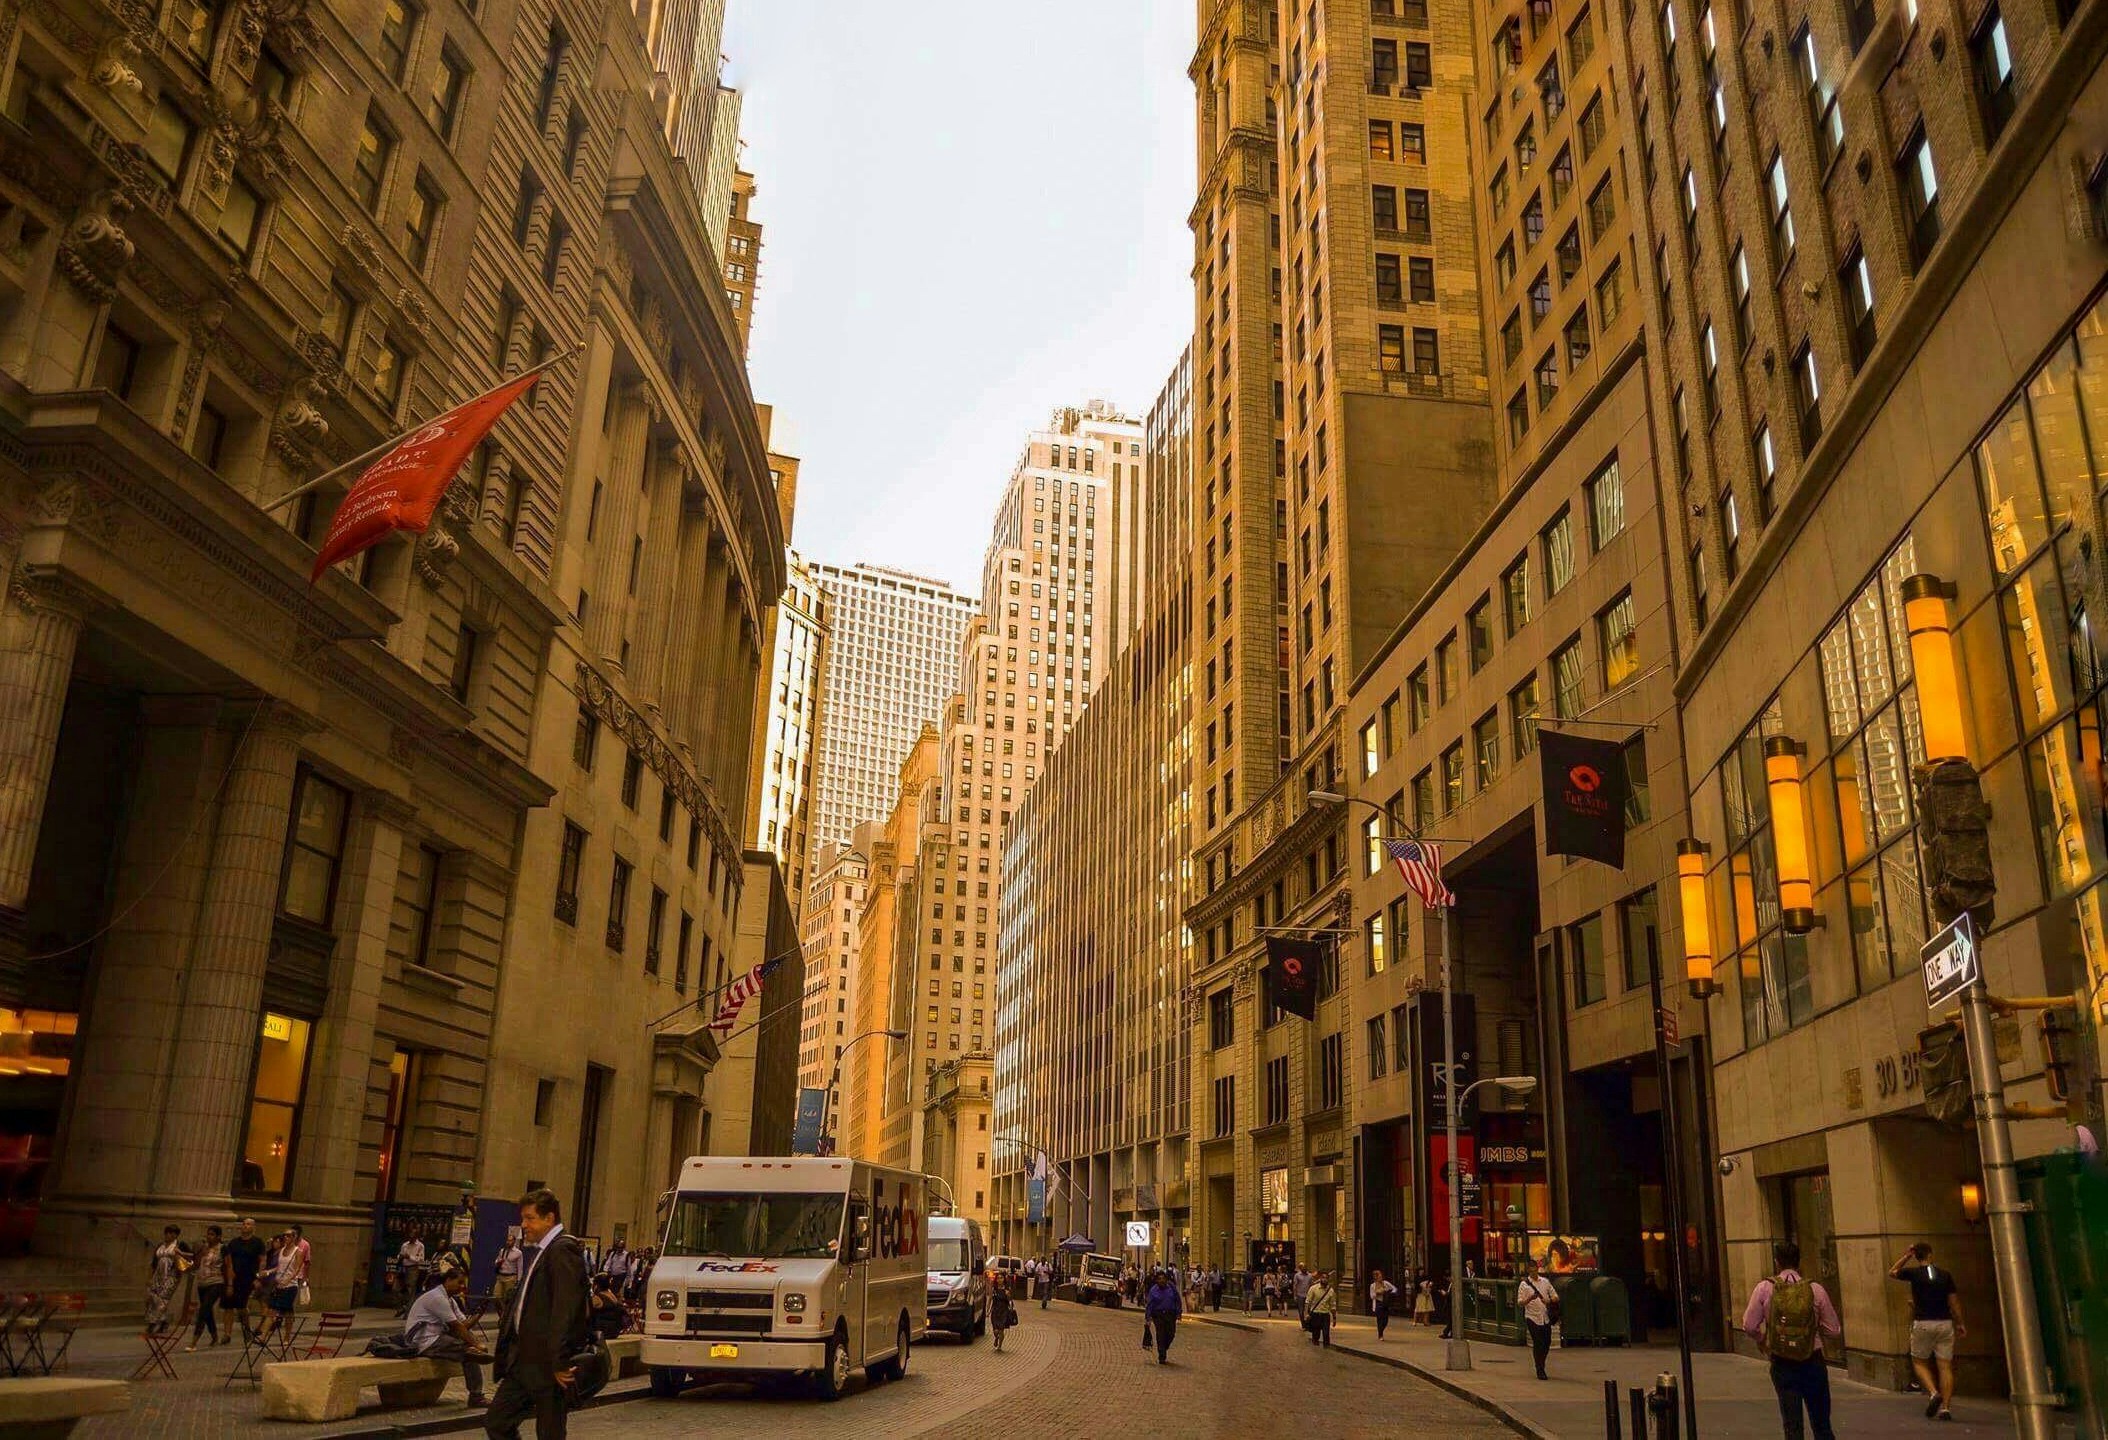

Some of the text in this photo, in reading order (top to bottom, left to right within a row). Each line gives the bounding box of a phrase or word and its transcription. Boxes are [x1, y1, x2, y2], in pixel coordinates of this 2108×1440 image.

[353, 500, 393, 524] Rentals
[1926, 938, 1967, 985] ONE WAY
[1873, 1054, 1898, 1099] 30
[872, 1178, 921, 1260] FedEx
[696, 1261, 781, 1273] FedEx
